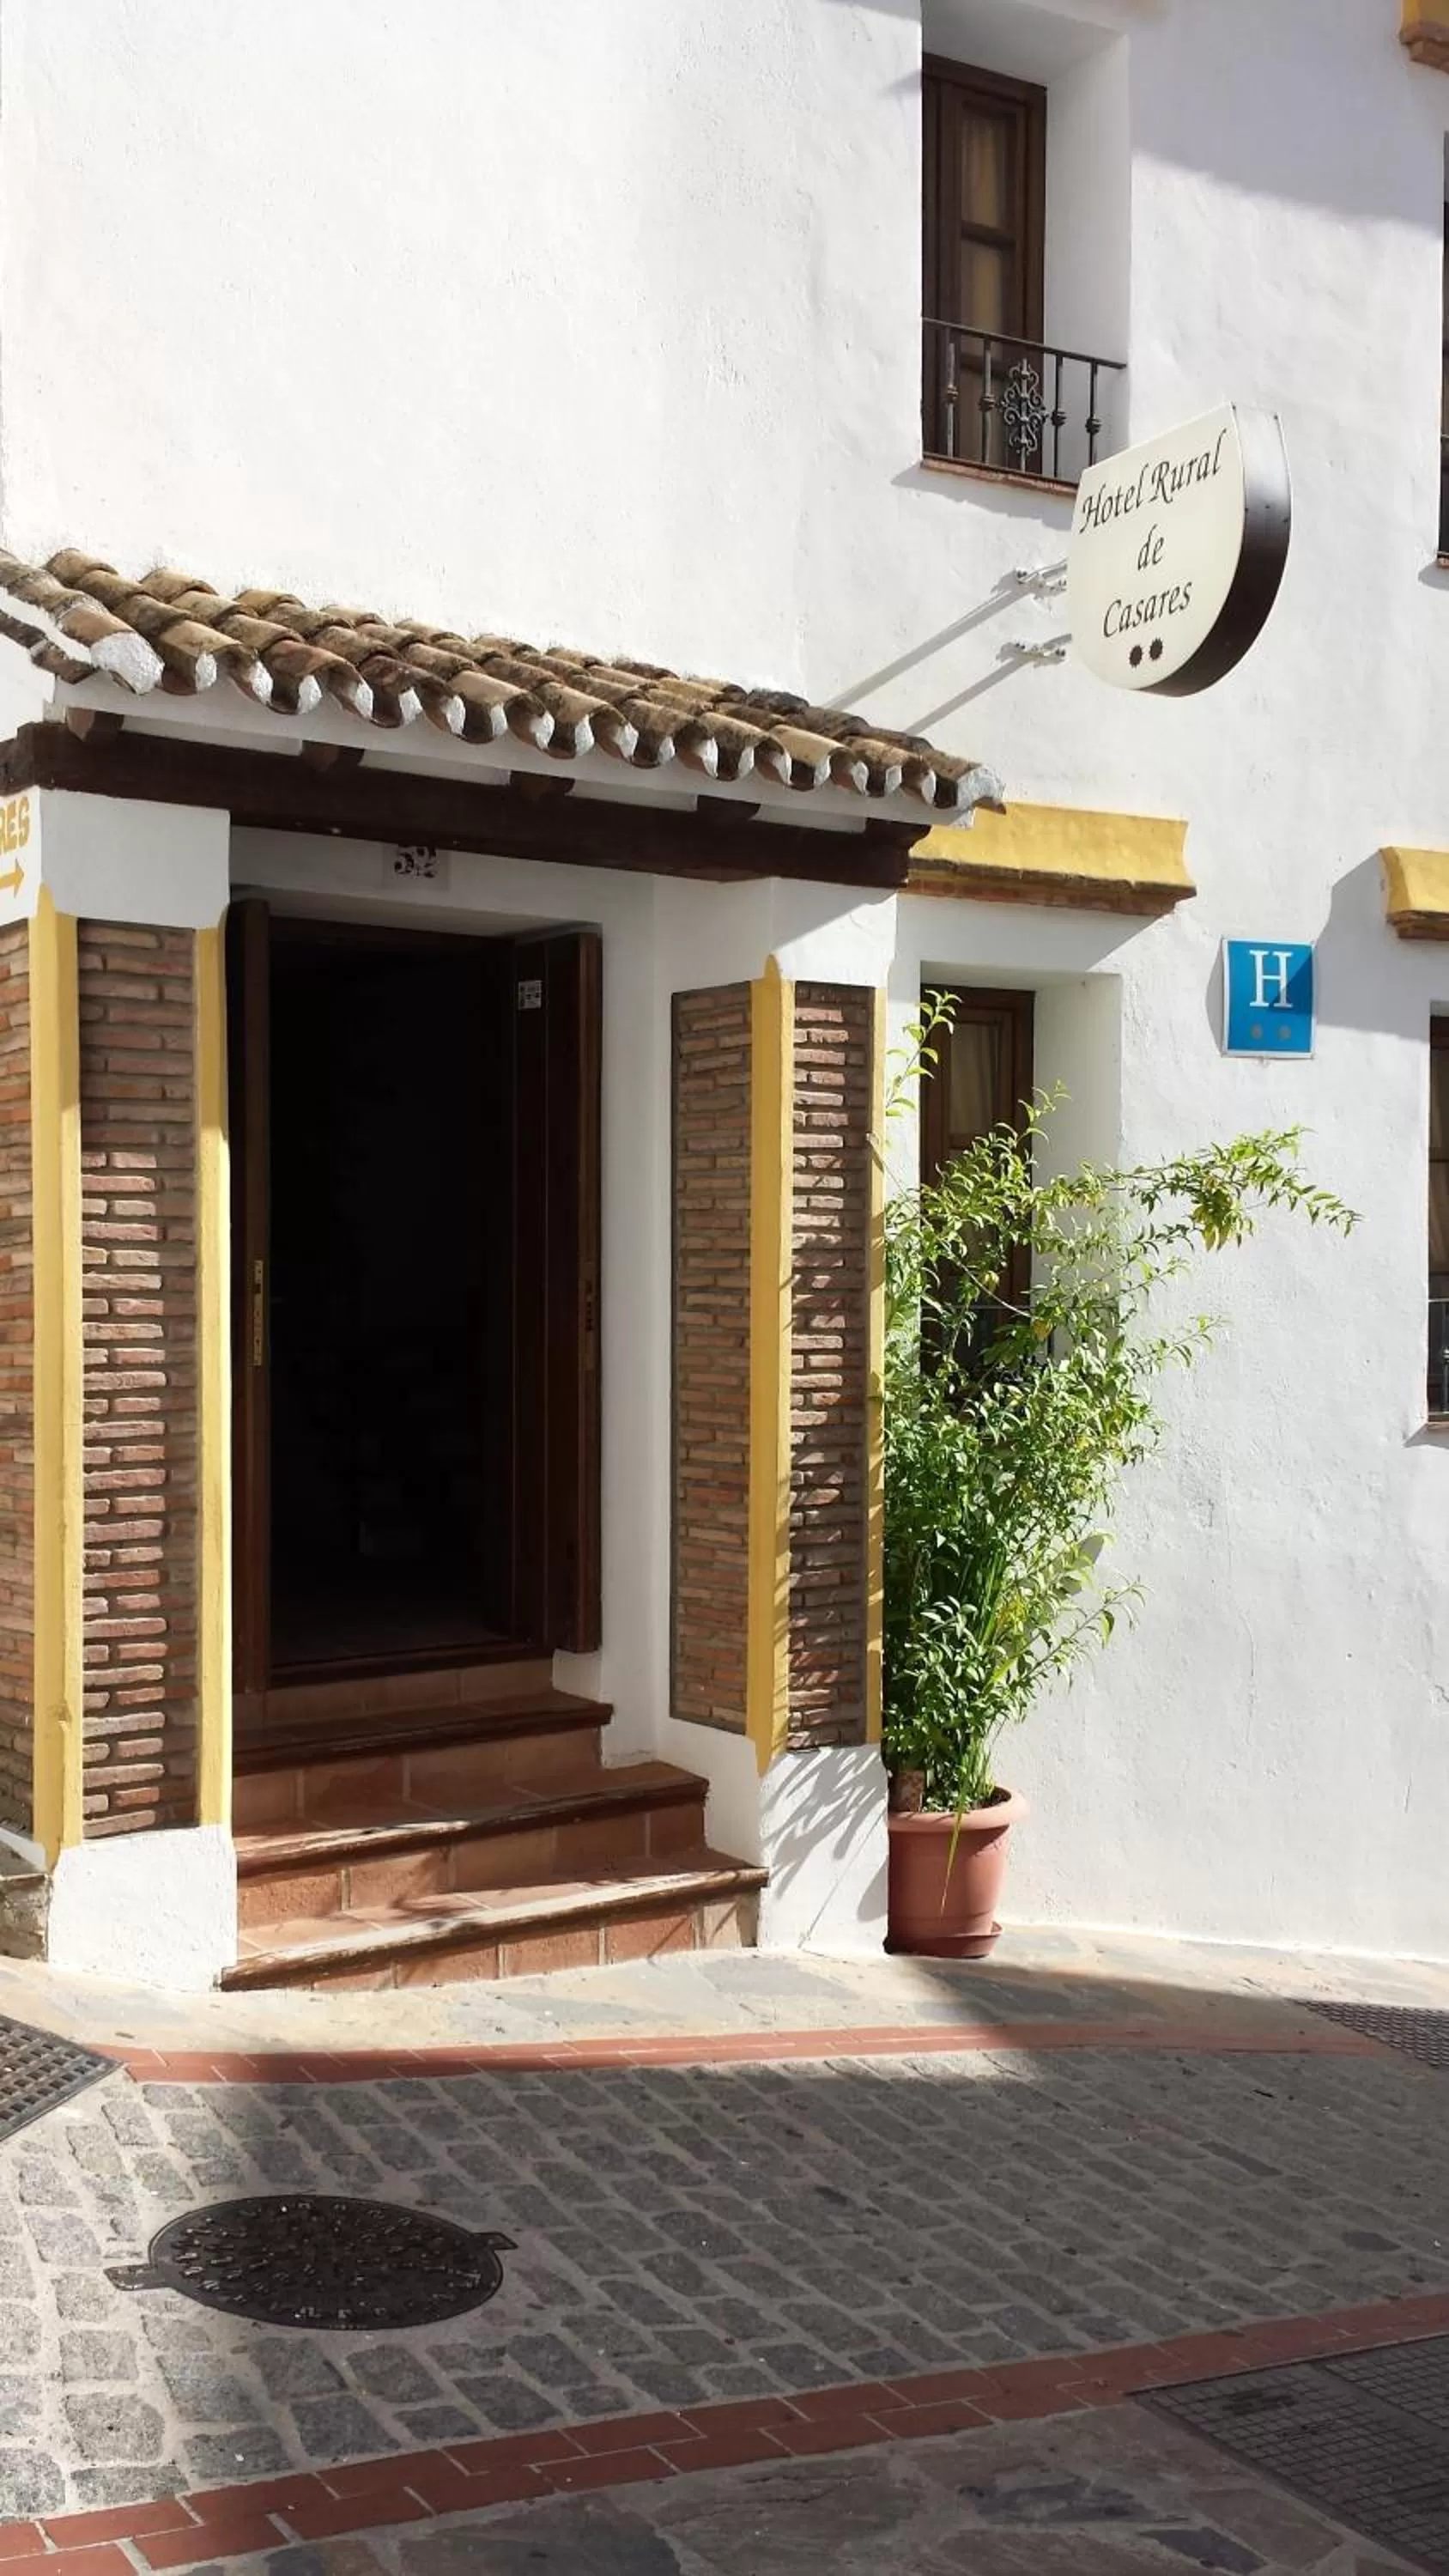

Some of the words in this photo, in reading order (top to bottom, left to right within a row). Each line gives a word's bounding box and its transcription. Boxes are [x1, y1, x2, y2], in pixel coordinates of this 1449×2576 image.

[1079, 462, 1150, 534] Hotel
[1149, 427, 1228, 506] Rural
[1137, 524, 1165, 570] de
[1102, 580, 1193, 638] Casares
[1249, 949, 1294, 1008] H
